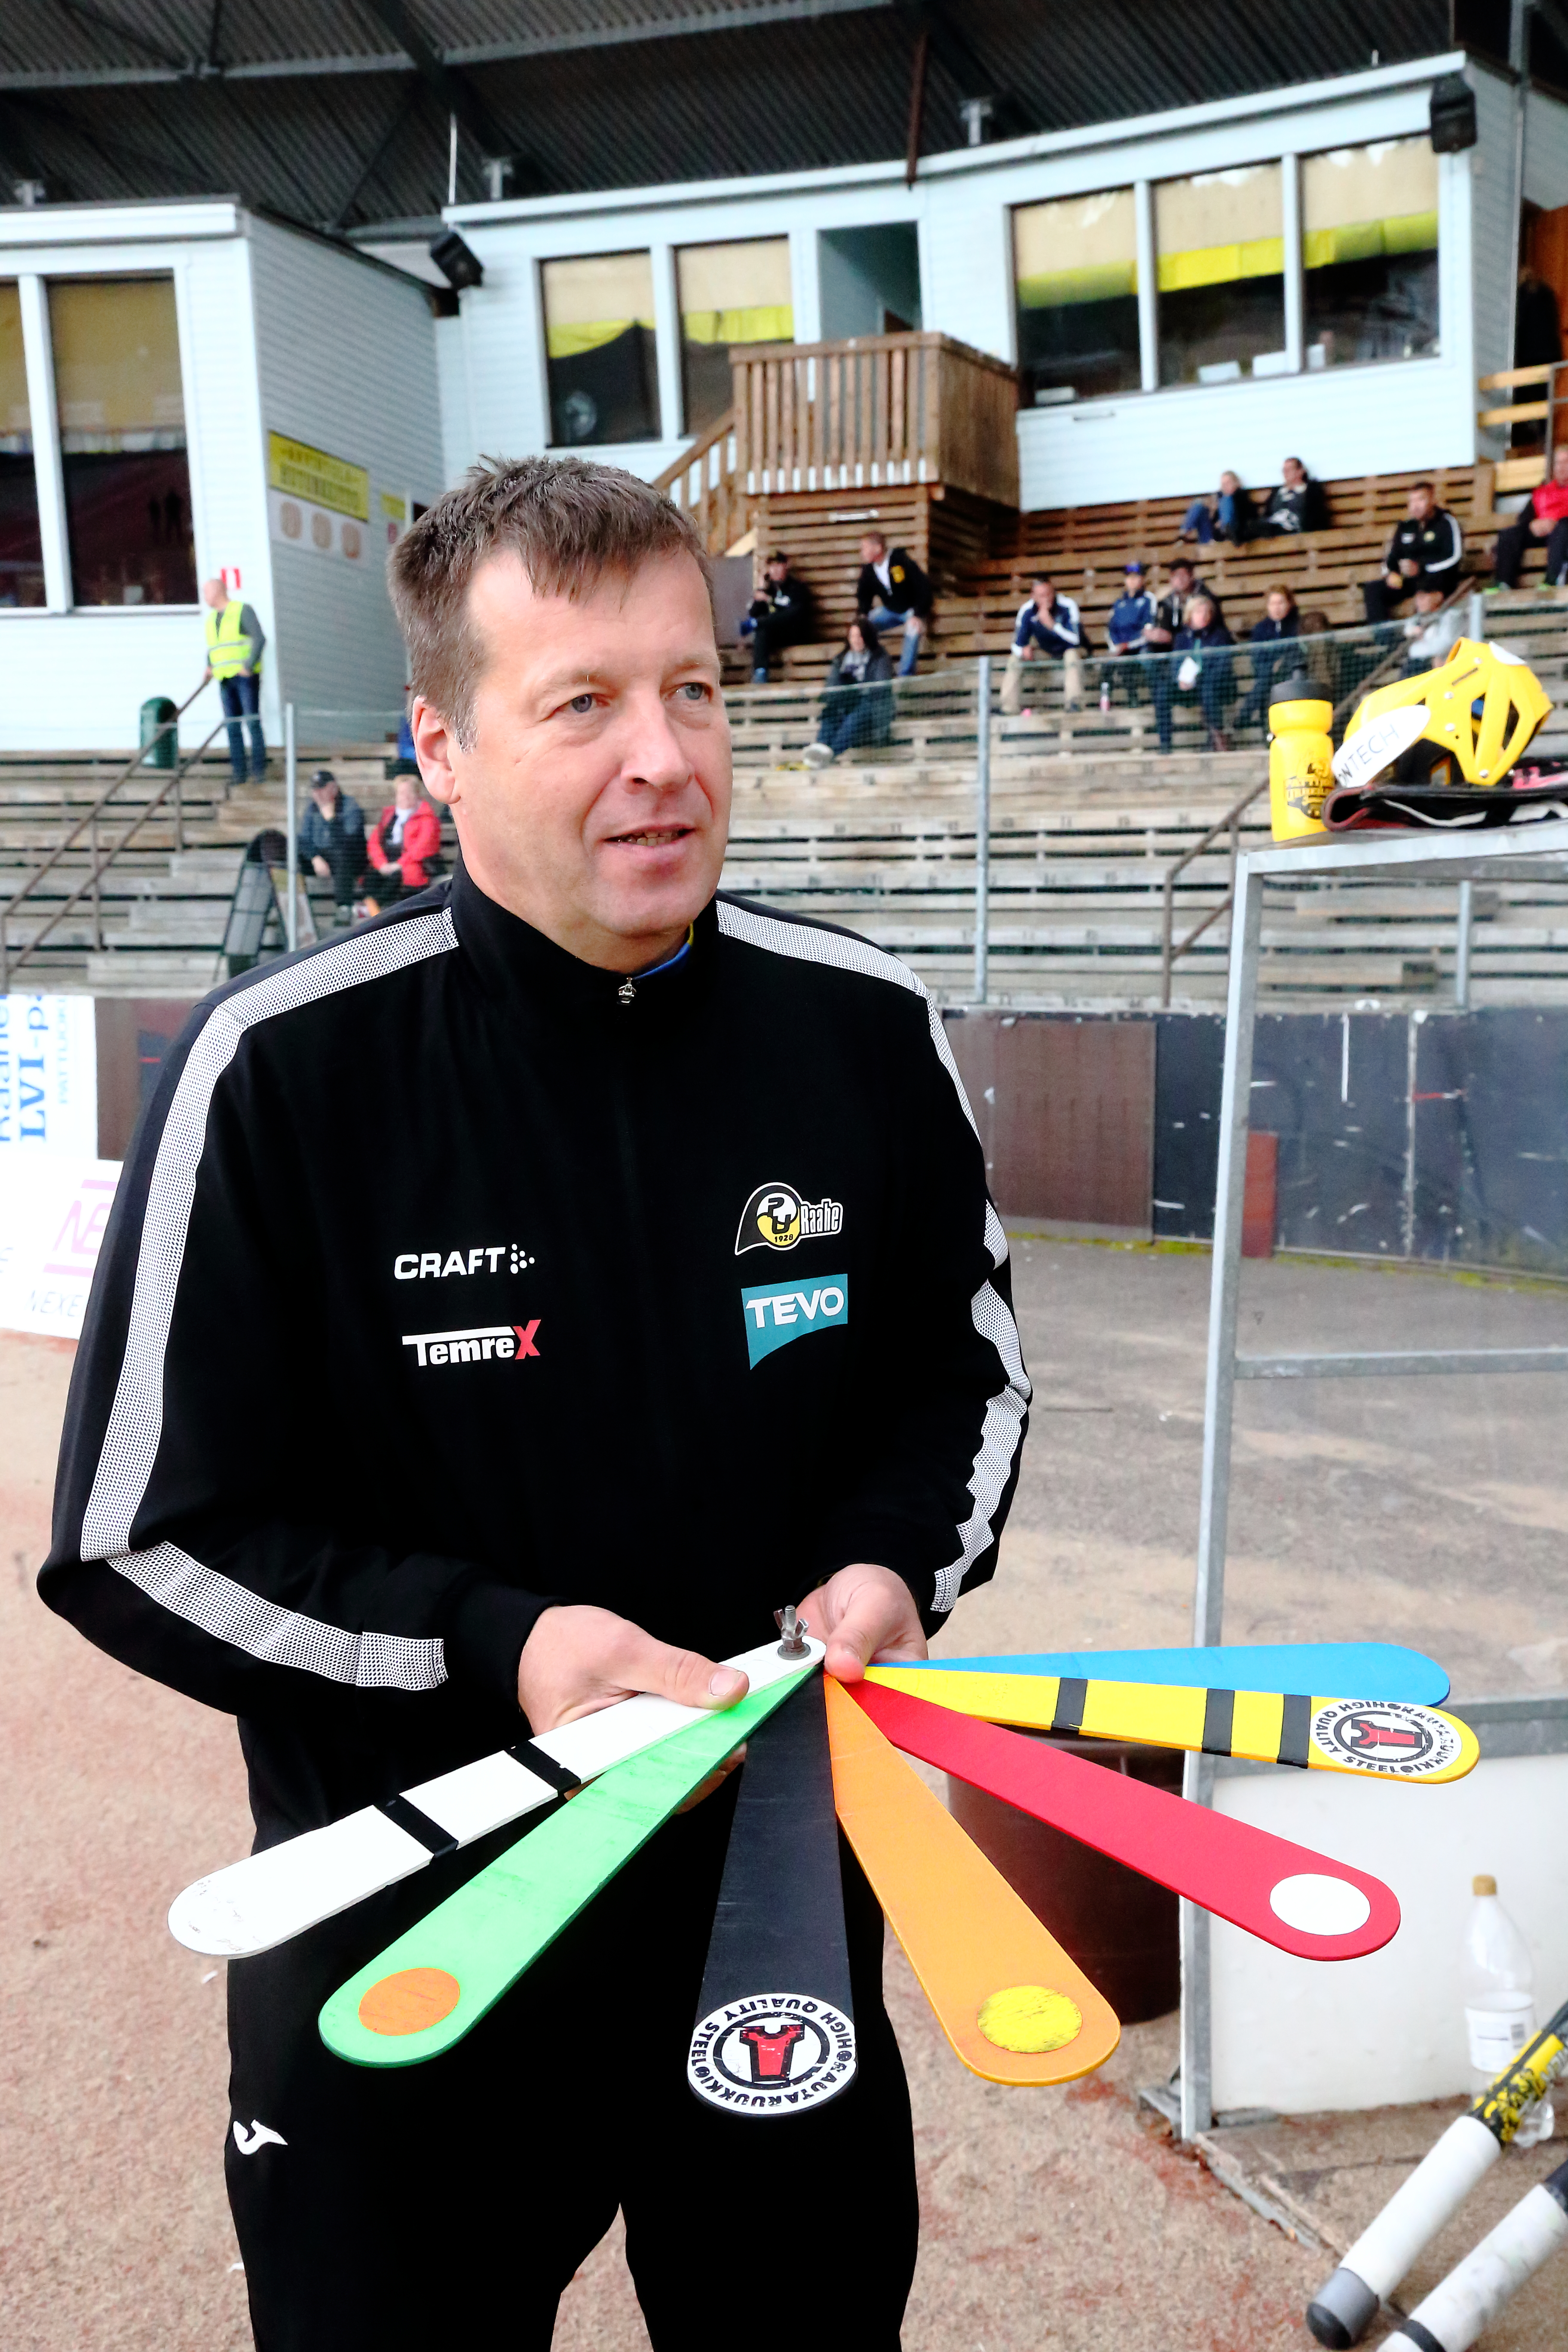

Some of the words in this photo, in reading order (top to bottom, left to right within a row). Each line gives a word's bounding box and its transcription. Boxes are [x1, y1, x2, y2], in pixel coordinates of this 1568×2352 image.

[801, 1204, 839, 1234] Raahe
[774, 1234, 794, 1243] 1928
[394, 1247, 506, 1280] CRAFT
[745, 1287, 845, 1328] TEVO
[1338, 1701, 1385, 1712] HIGH
[1316, 1711, 1343, 1752] QUALITY
[1343, 1756, 1400, 1774] STEEL
[724, 1998, 818, 2021] QUALITY
[691, 2022, 720, 2066] STEEL
[820, 2012, 853, 2049] HIGH
[700, 2061, 847, 2107] RAUTARUUKKI
